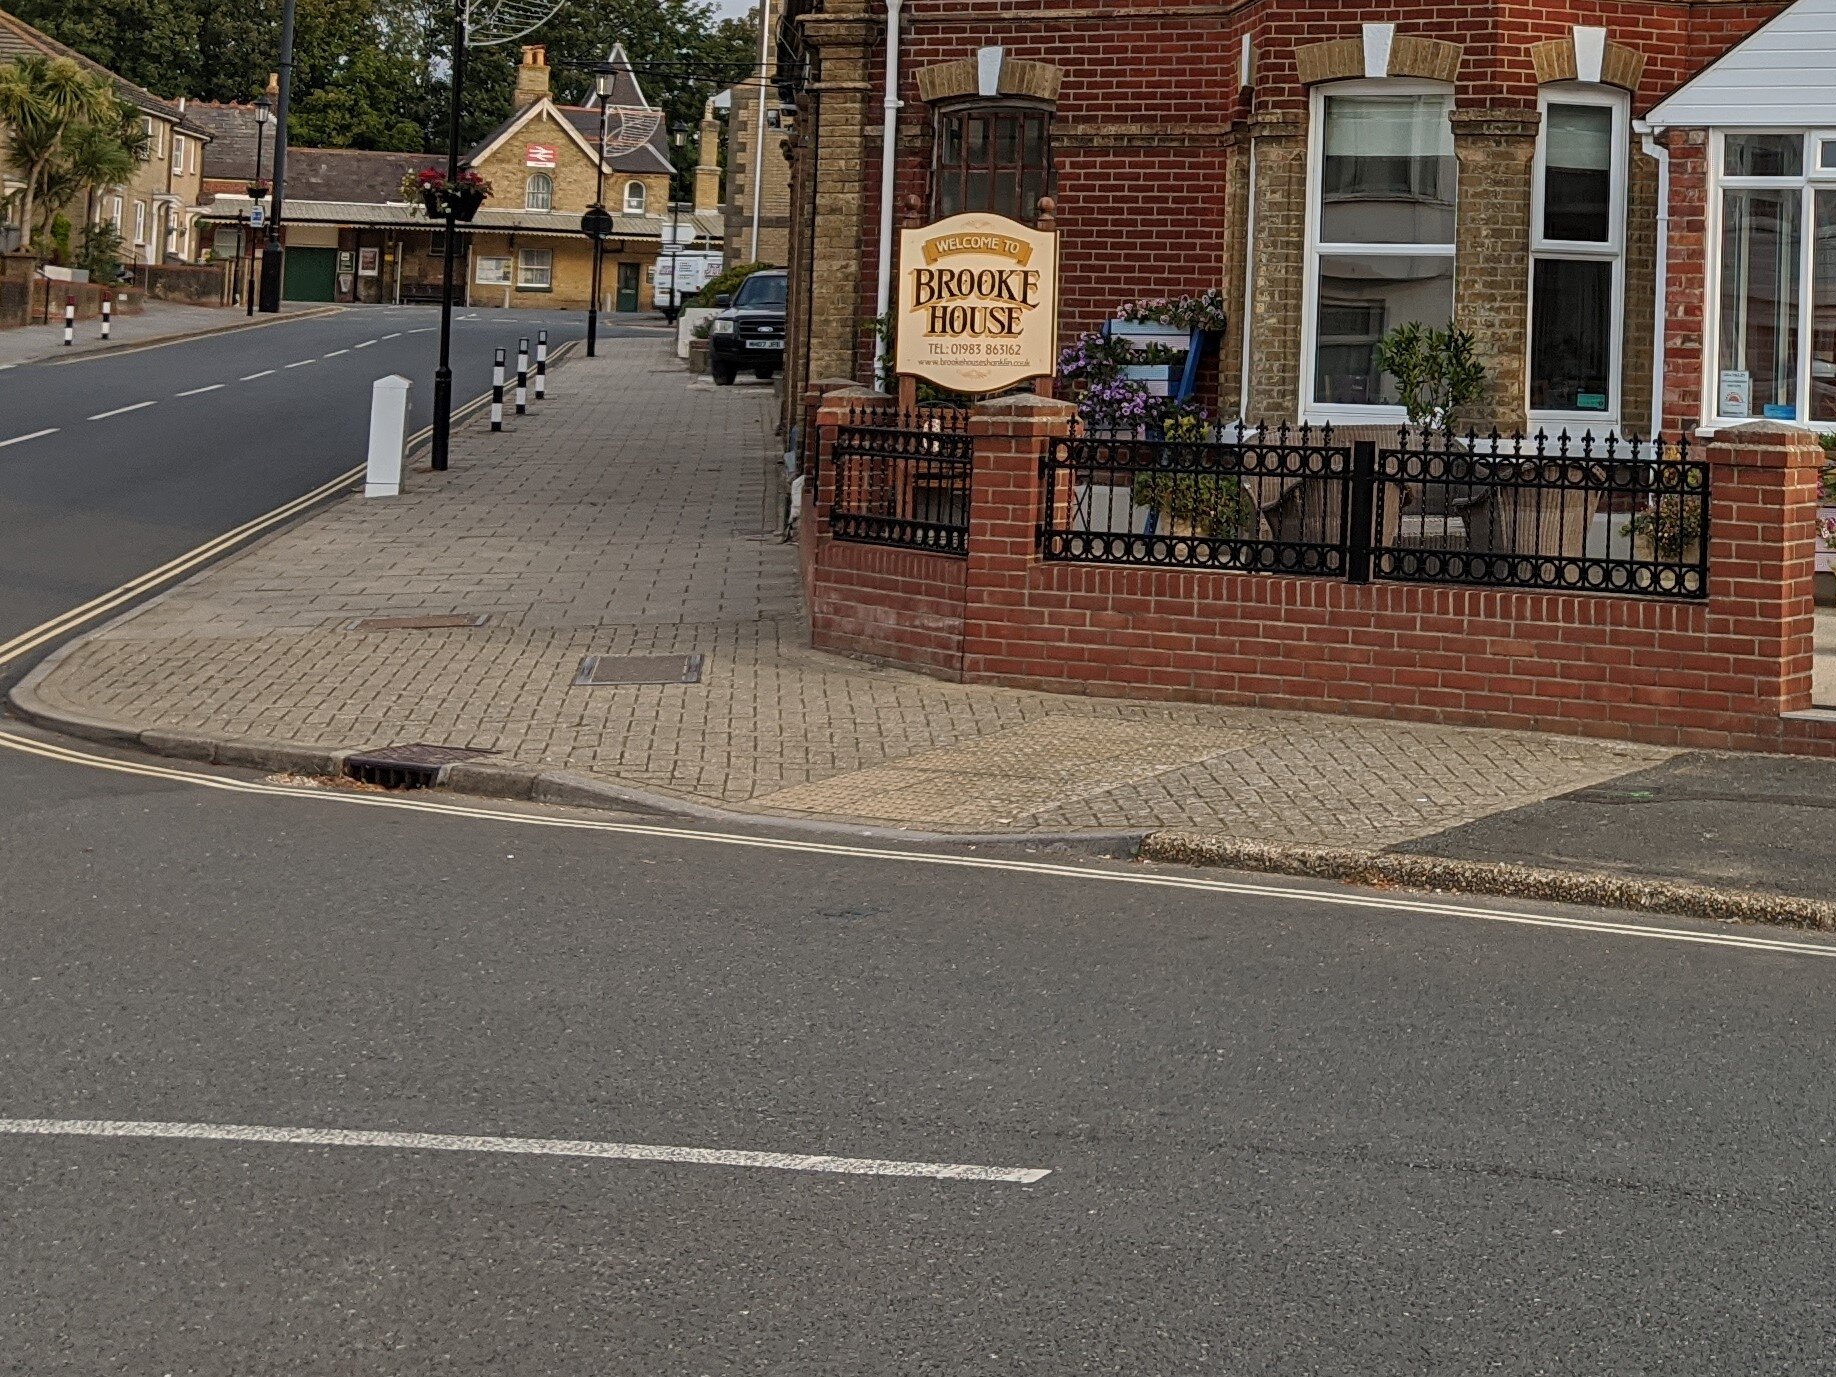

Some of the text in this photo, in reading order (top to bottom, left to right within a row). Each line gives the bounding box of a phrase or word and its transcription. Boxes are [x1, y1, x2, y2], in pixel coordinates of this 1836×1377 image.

[937, 236, 1019, 253] WELCOME TO
[911, 268, 1040, 310] BROOKE
[926, 305, 1024, 336] HOUSE
[928, 343, 1022, 356] TEL: 01983 863162
